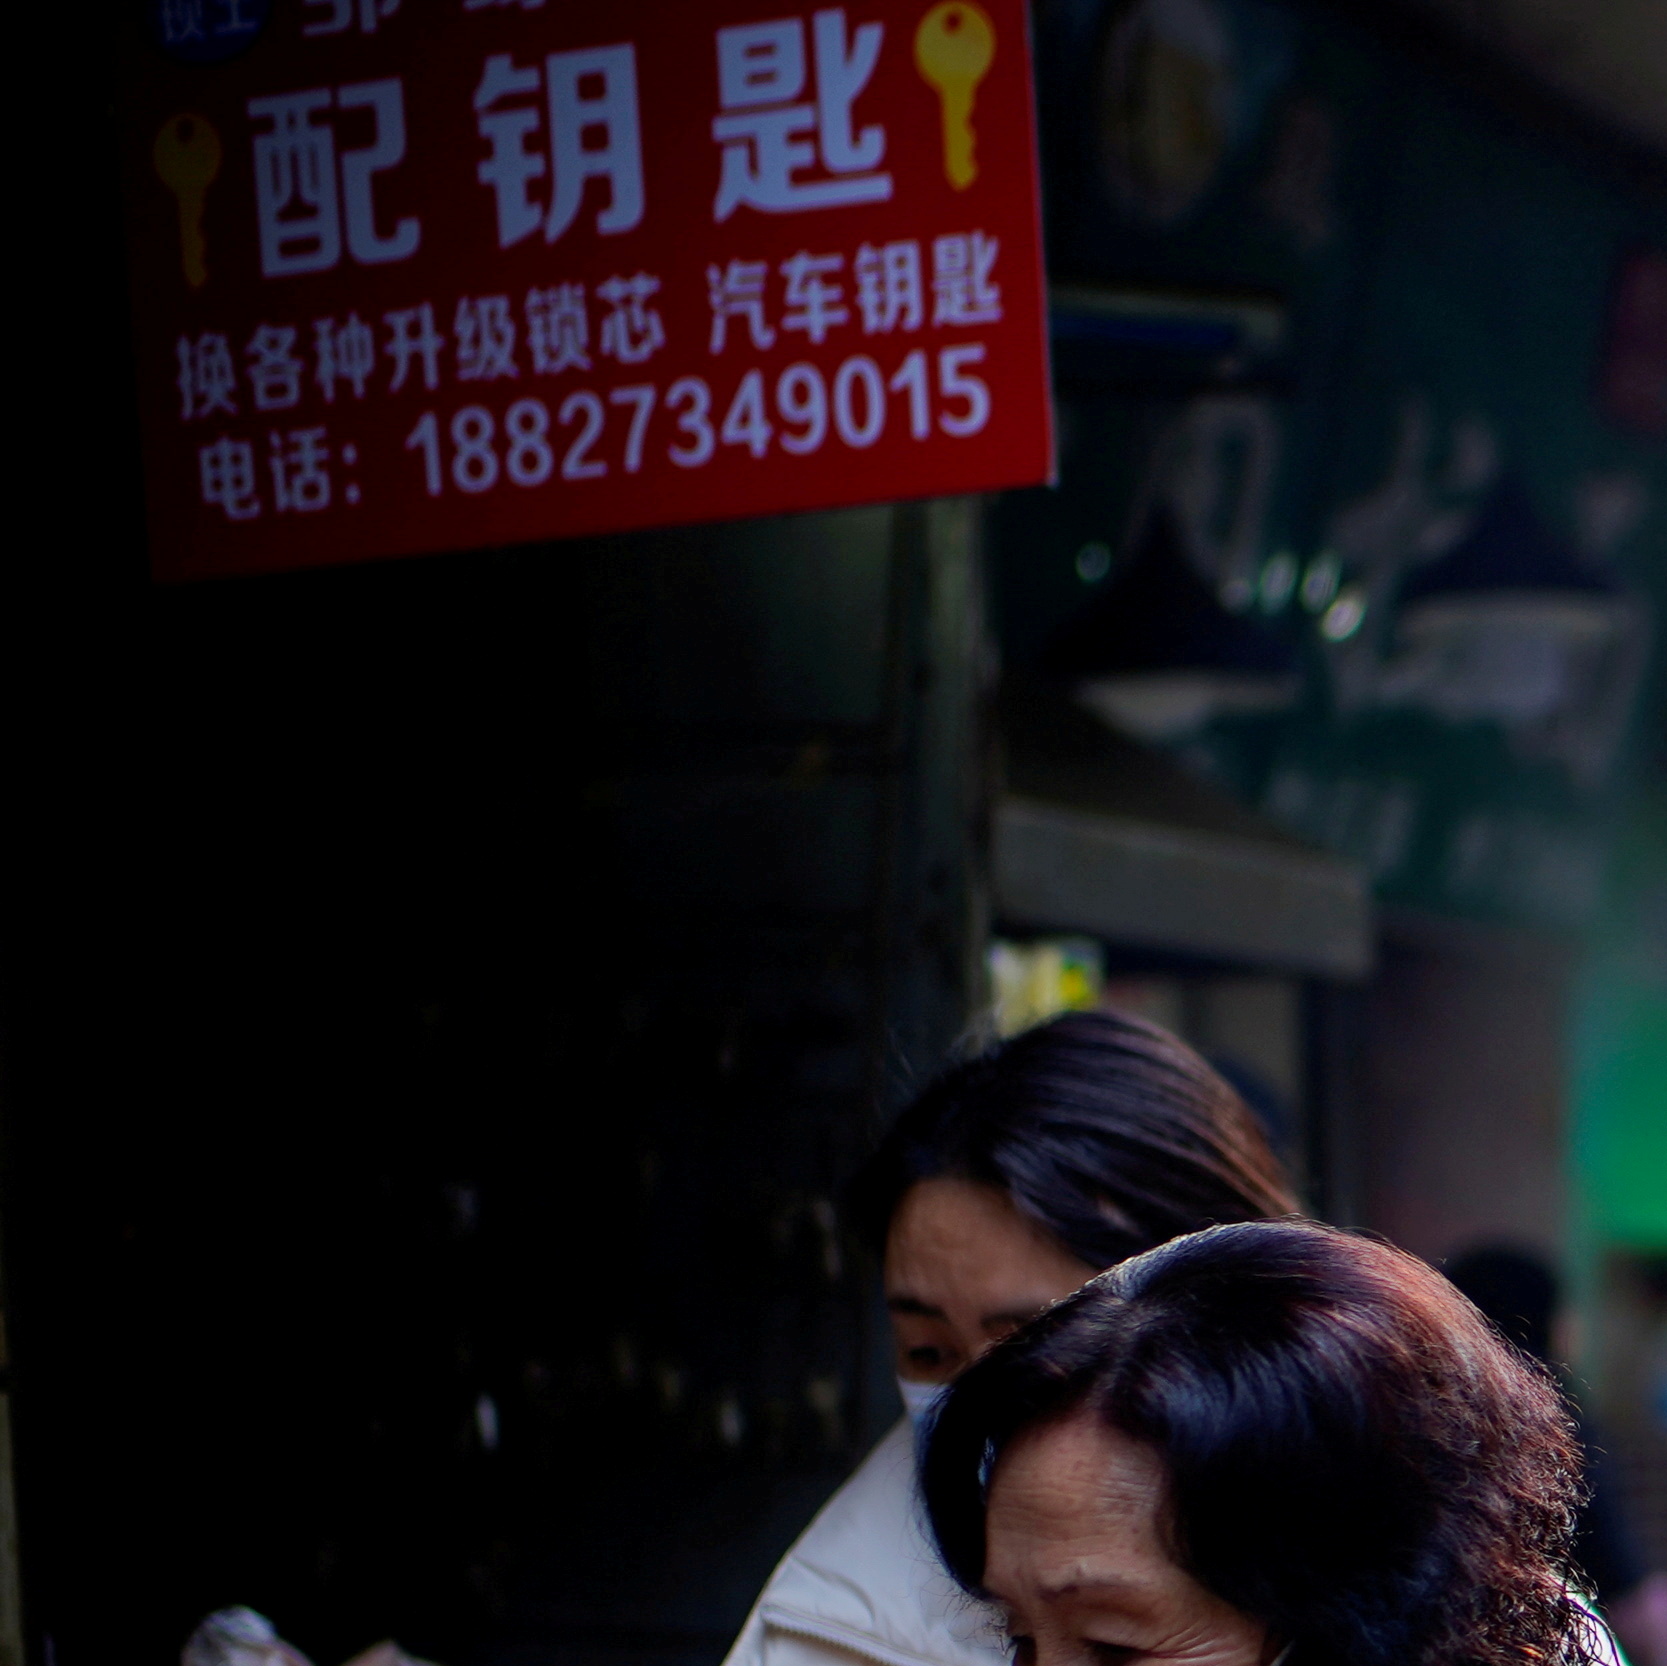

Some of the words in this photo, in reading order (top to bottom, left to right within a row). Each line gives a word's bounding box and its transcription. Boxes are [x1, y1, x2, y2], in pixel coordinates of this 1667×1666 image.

[248, 8, 895, 276] 配钥匙
[176, 272, 666, 420] 换各种升级锁芯
[706, 229, 1003, 354] 汽车钥匙
[407, 344, 990, 496] 18827349015
